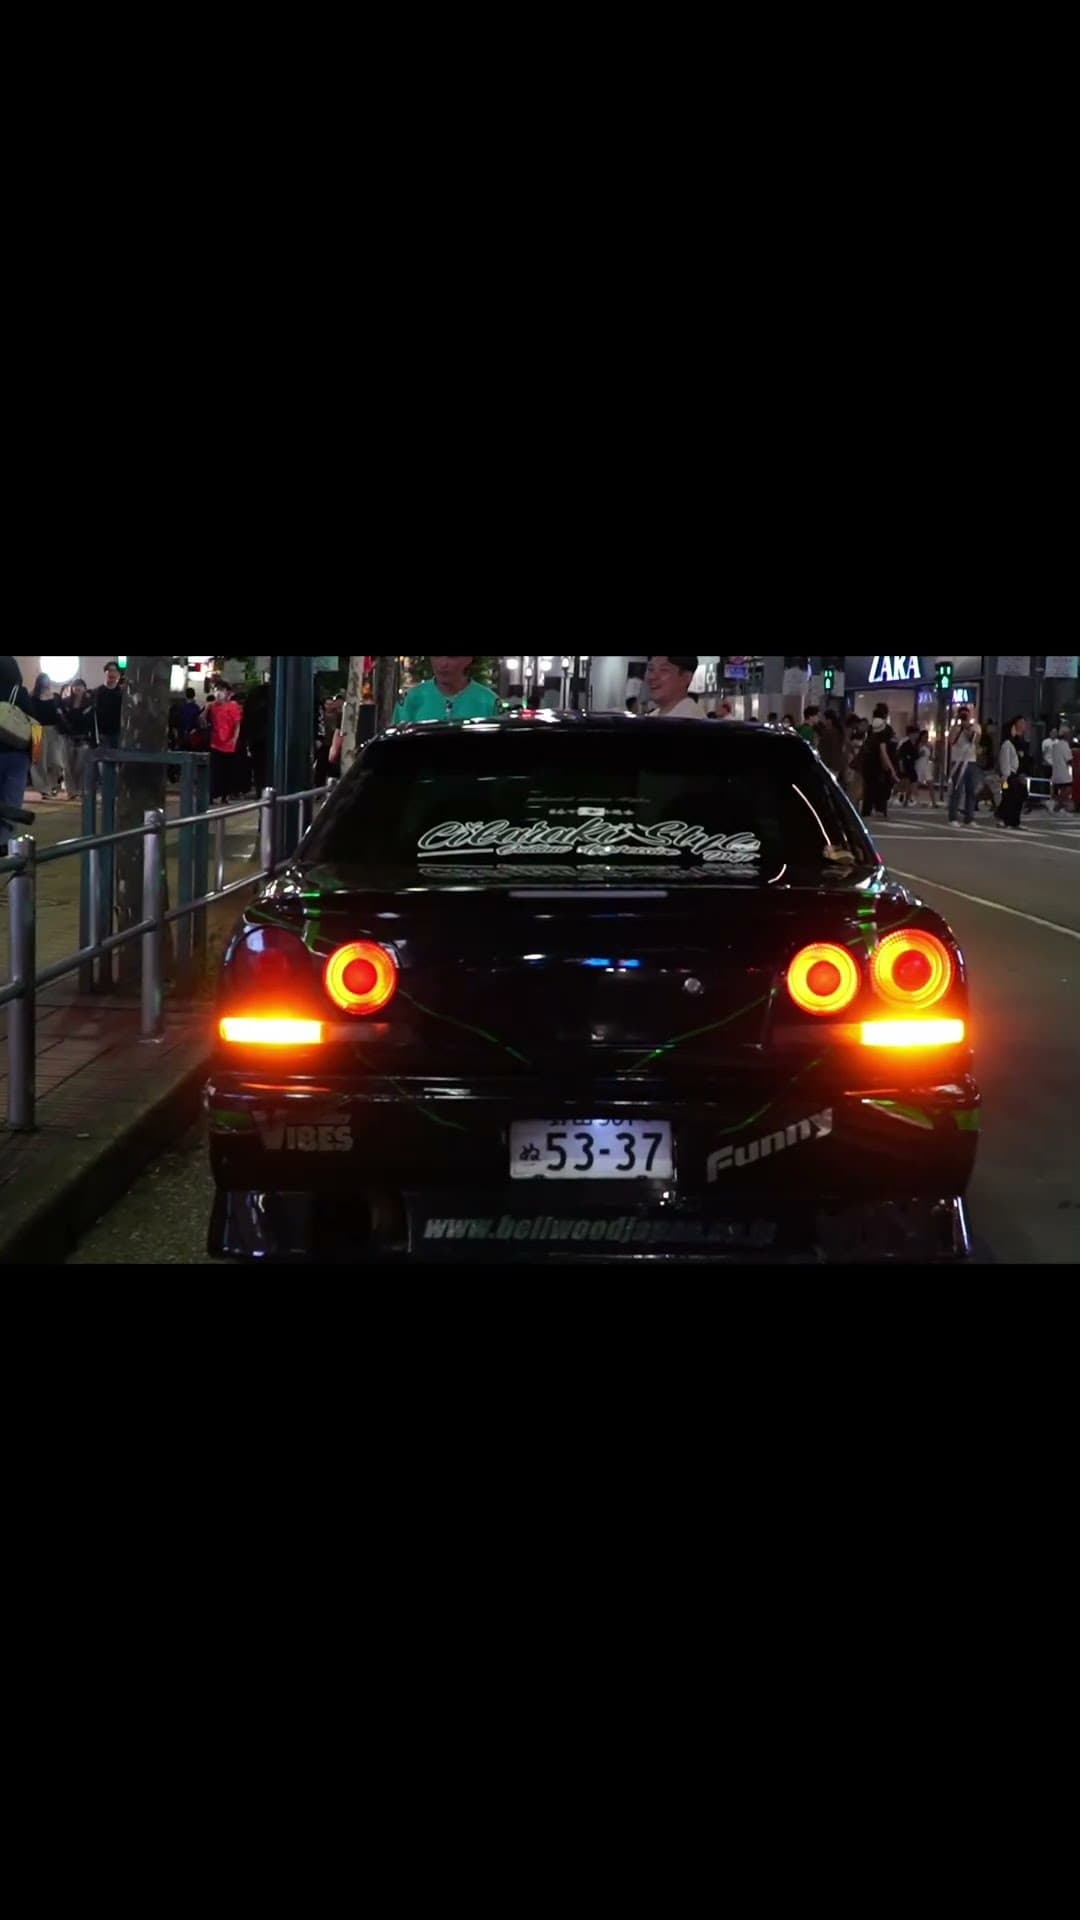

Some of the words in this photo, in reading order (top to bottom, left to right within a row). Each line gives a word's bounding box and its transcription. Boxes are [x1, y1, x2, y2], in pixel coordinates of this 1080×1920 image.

[868, 656, 921, 683] ZARA
[251, 1109, 353, 1152] VIBES
[706, 1107, 833, 1183] Funny
[546, 1132, 663, 1172] 53-37
